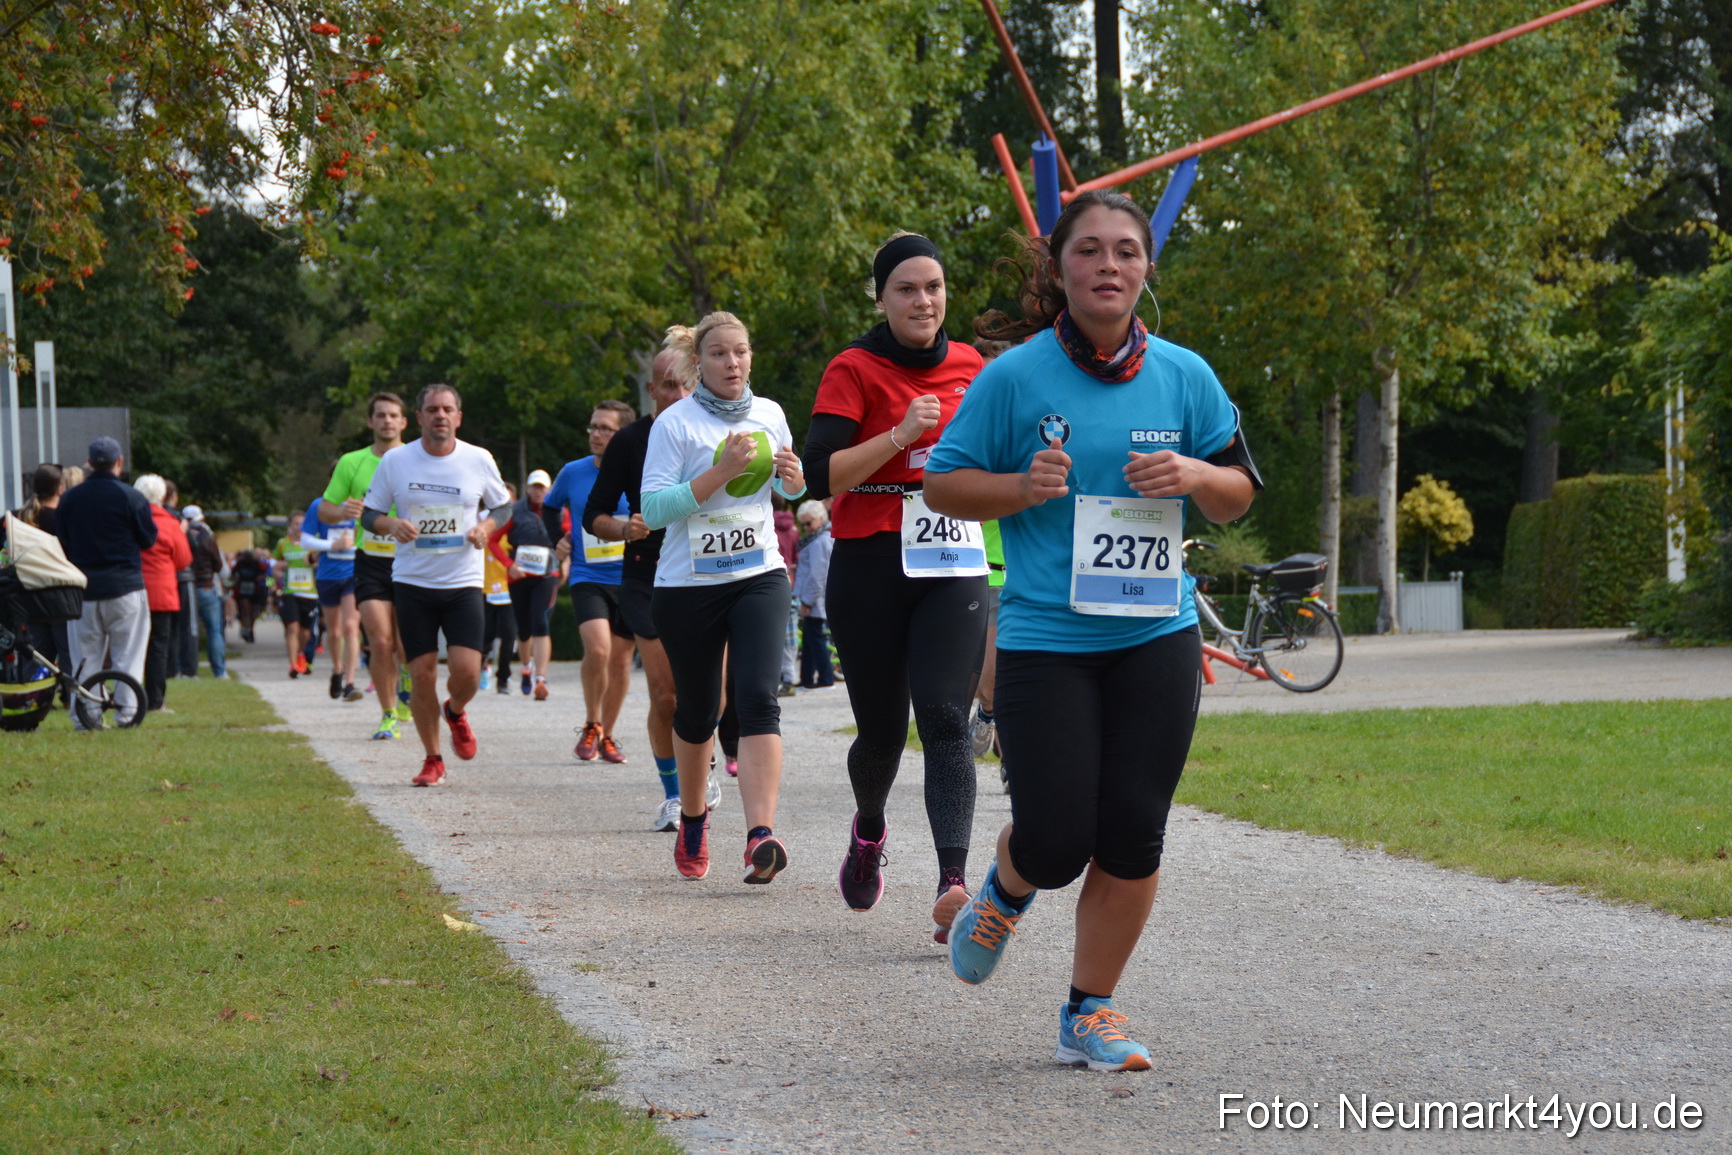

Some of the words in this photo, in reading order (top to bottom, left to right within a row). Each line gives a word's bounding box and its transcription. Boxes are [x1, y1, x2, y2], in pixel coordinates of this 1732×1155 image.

[1131, 429, 1181, 443] BOCK
[854, 485, 904, 493] CHAMPION
[1123, 509, 1162, 520] BOCK
[419, 518, 456, 534] 2224
[915, 516, 971, 544] 2481
[702, 527, 756, 554] 2126
[939, 551, 959, 562] Anja
[1092, 533, 1170, 571] 2378
[716, 557, 745, 569] Corinna
[1080, 562, 1085, 570] D
[1122, 582, 1144, 596] Lisa
